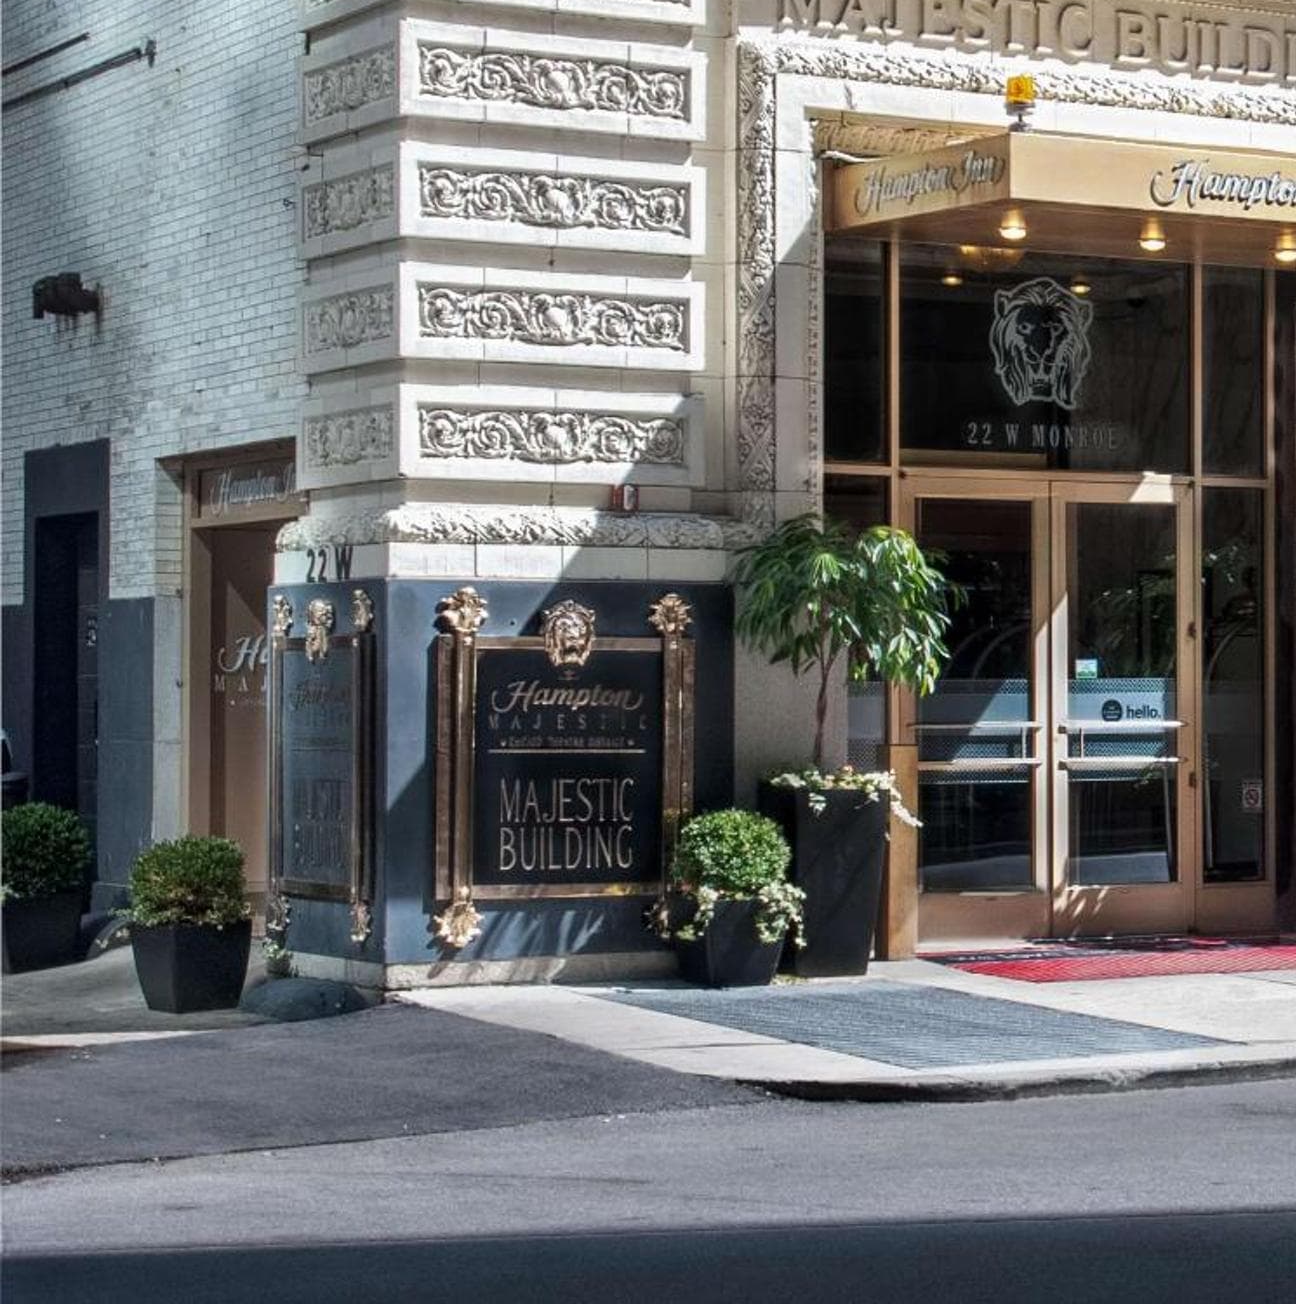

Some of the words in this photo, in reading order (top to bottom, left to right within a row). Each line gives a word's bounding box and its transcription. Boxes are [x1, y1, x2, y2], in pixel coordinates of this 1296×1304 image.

[855, 165, 957, 217] Hampton
[957, 150, 1005, 193] Inn
[967, 421, 993, 445] 22
[1005, 423, 1019, 447] W
[1032, 423, 1118, 449] MONROE
[307, 548, 327, 584] 22
[335, 544, 353, 581] W
[491, 681, 643, 713] Hampton
[489, 714, 647, 730] MAJESTIC
[500, 777, 634, 823] MAJESTIC
[500, 824, 634, 871] BUILDING
